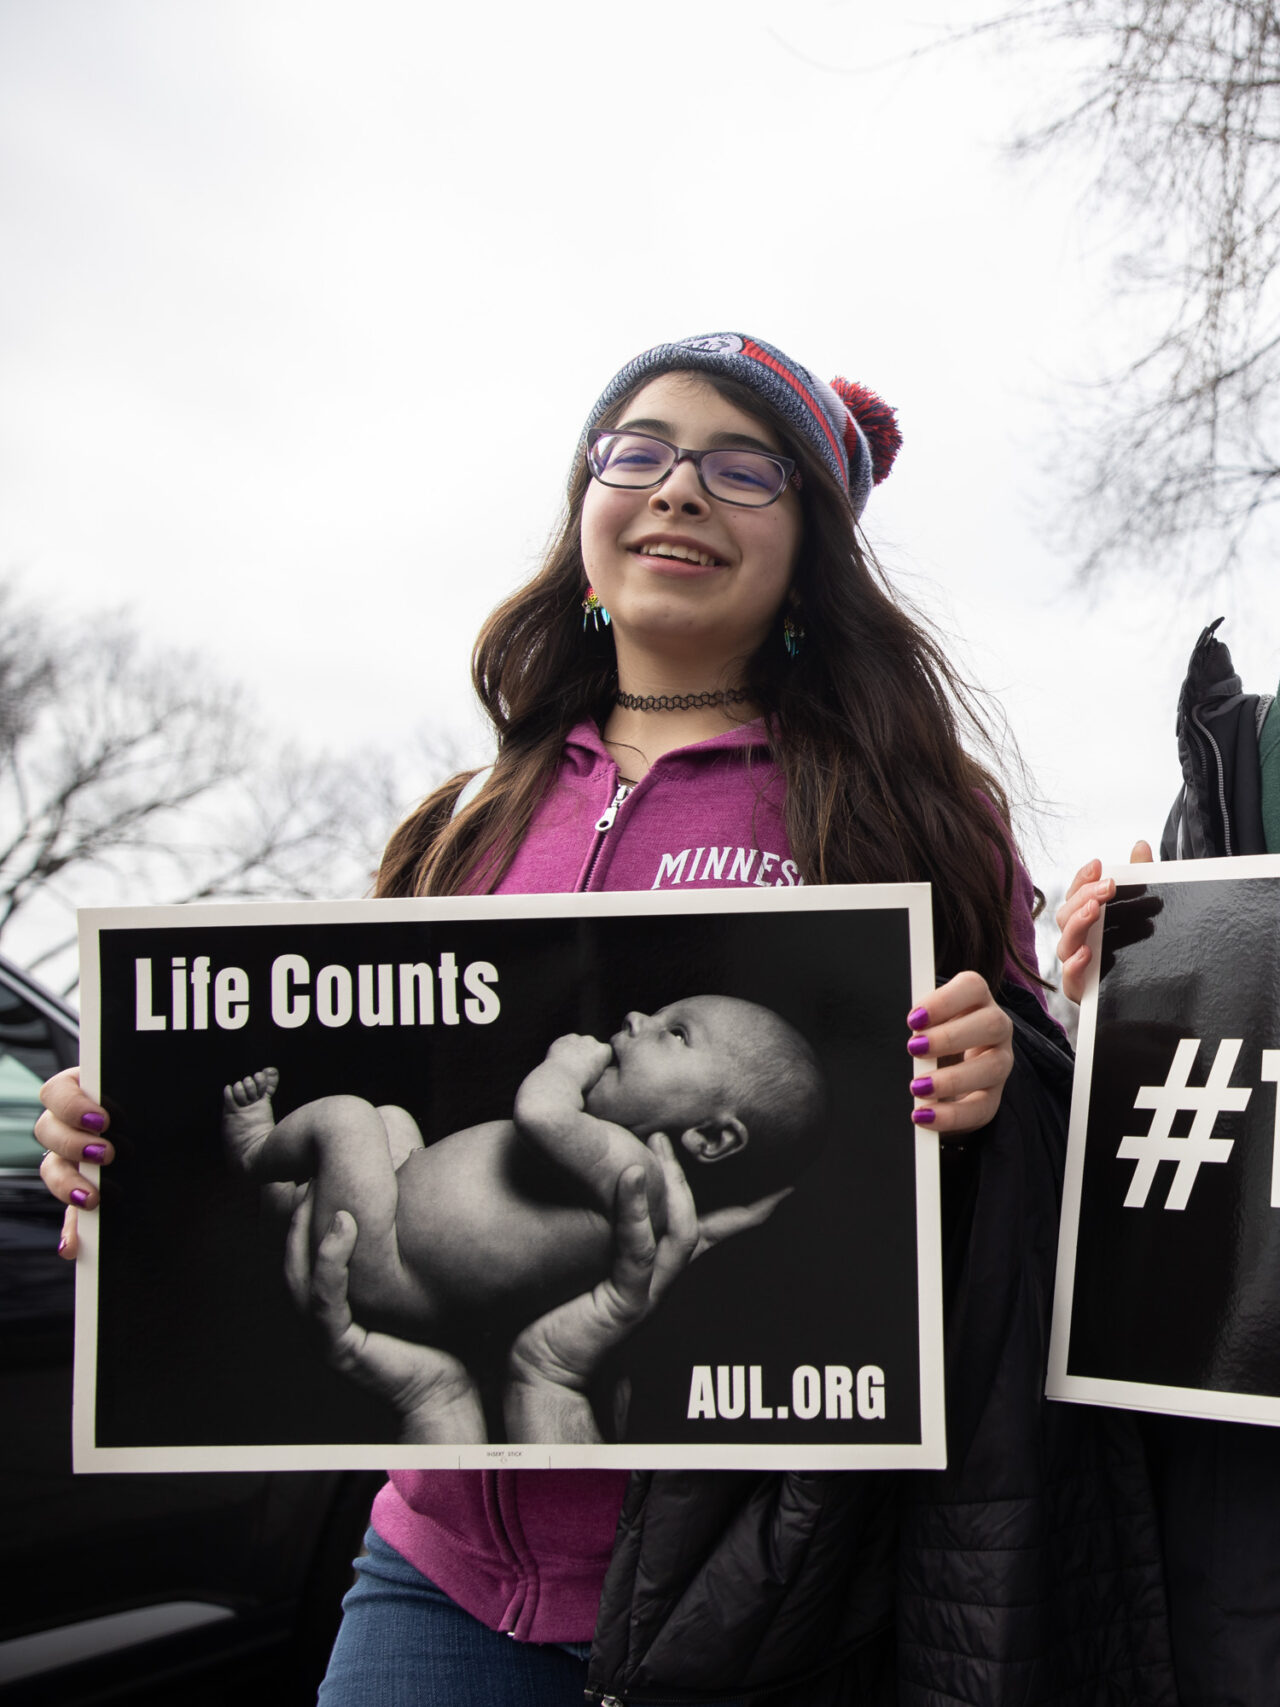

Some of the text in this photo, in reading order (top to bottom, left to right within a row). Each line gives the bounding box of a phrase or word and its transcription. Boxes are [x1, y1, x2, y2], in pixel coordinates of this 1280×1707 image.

[651, 846, 805, 890] MINNES
[135, 952, 501, 1031] Life Counts
[687, 1365, 886, 1420] AUL.ORG
